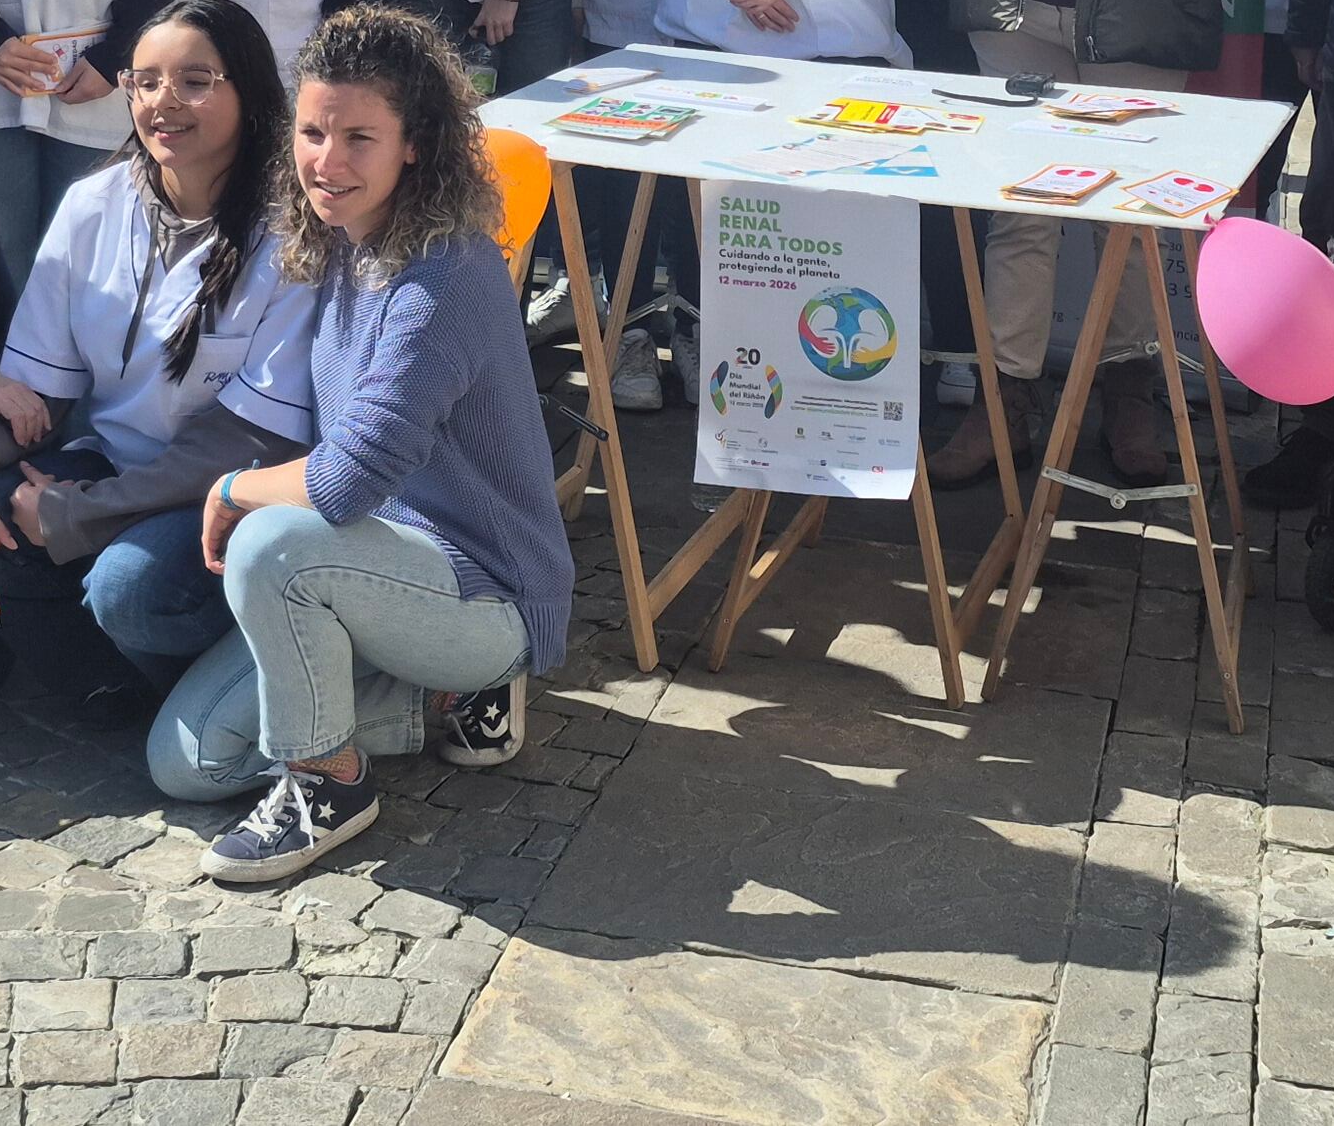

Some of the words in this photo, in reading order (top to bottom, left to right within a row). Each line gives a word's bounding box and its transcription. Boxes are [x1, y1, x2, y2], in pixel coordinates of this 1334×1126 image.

[719, 196, 781, 215] SALUD
[719, 214, 783, 233] RENAL
[719, 232, 772, 250] PARA
[778, 236, 844, 256] TODOS
[719, 248, 770, 262] Cuidando
[773, 254, 782, 262] a
[784, 252, 793, 263] la
[796, 256, 831, 269] gente,
[718, 261, 783, 276] protegiendo
[786, 265, 796, 275] el
[799, 267, 841, 280] planeta
[719, 275, 730, 286] 12
[732, 277, 767, 289] marzo
[769, 279, 797, 290] 2026
[736, 347, 761, 365] 20
[729, 382, 761, 390] Mundial
[729, 391, 742, 399] del
